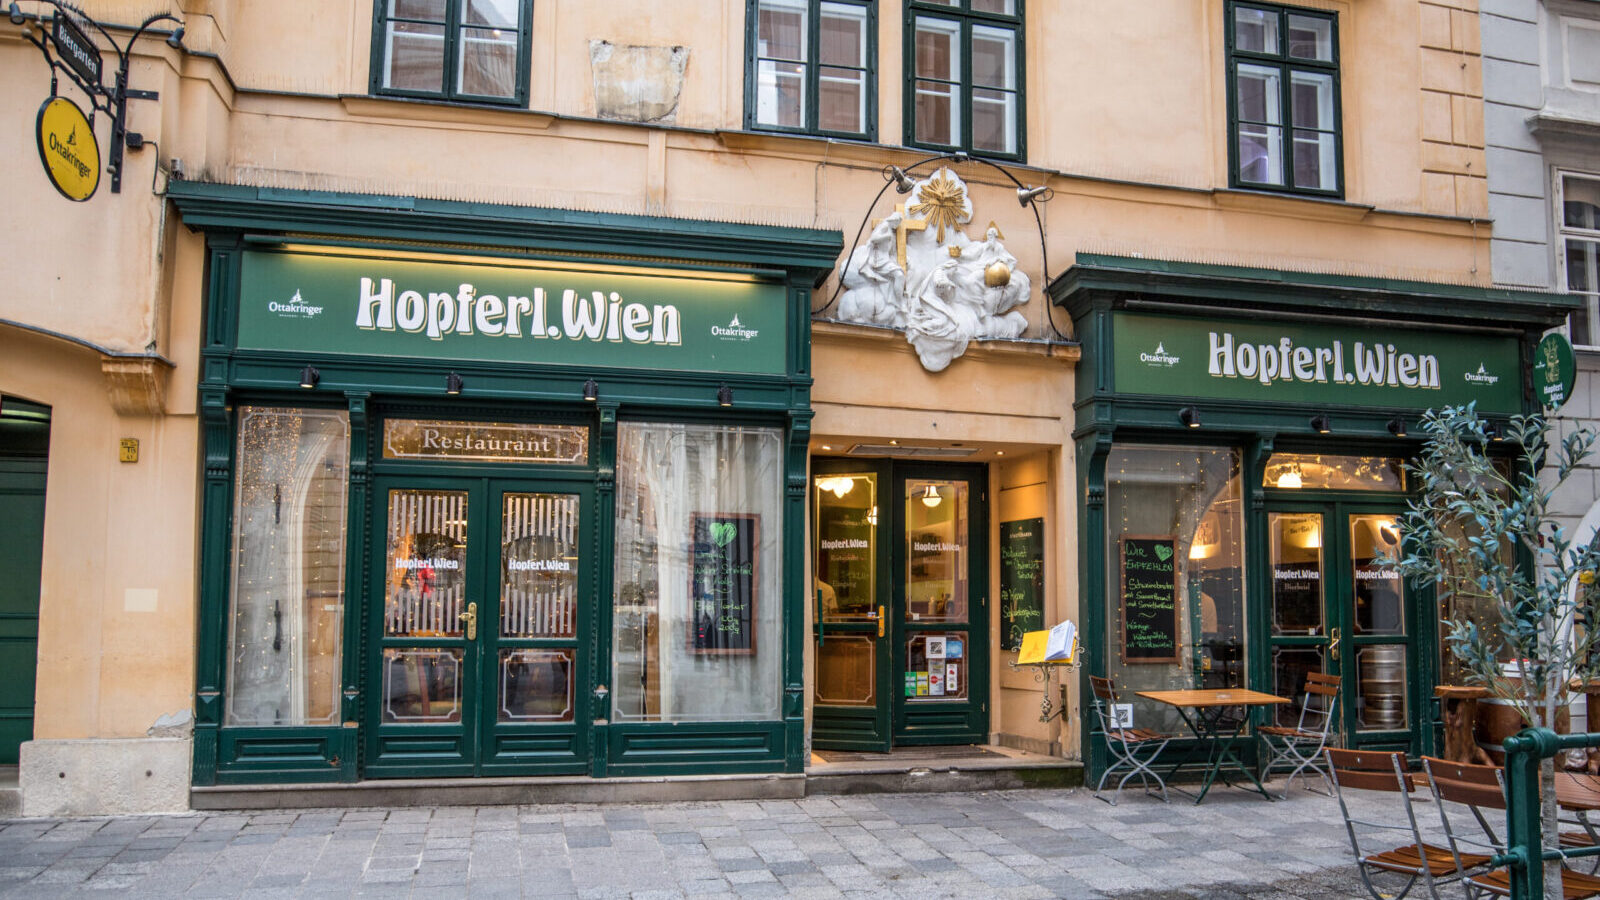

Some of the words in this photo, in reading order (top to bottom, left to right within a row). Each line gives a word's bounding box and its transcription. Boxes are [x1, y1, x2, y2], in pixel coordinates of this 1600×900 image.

[58, 25, 97, 75] Biergarten
[49, 132, 91, 178] Ottakringer
[268, 301, 323, 316] Ottakringer
[355, 277, 683, 346] Hopferl.Wien
[711, 325, 759, 339] Ottakringer
[1140, 352, 1180, 364] Ottakringer
[1207, 332, 1441, 390] Hopferl.Wien
[1464, 371, 1500, 384] Ottakringer
[422, 429, 551, 453] Restaurant
[821, 538, 868, 550] Hopferl.Wien
[914, 541, 960, 552] Hopferl.Wien
[395, 557, 458, 569] Hopferl.Wien
[508, 559, 570, 571] Hopferl.Wien
[1125, 560, 1173, 572] EMPFEHLEN
[1274, 569, 1320, 579] Hopferl.Wien
[1355, 569, 1399, 579] Hopferl.Wien
